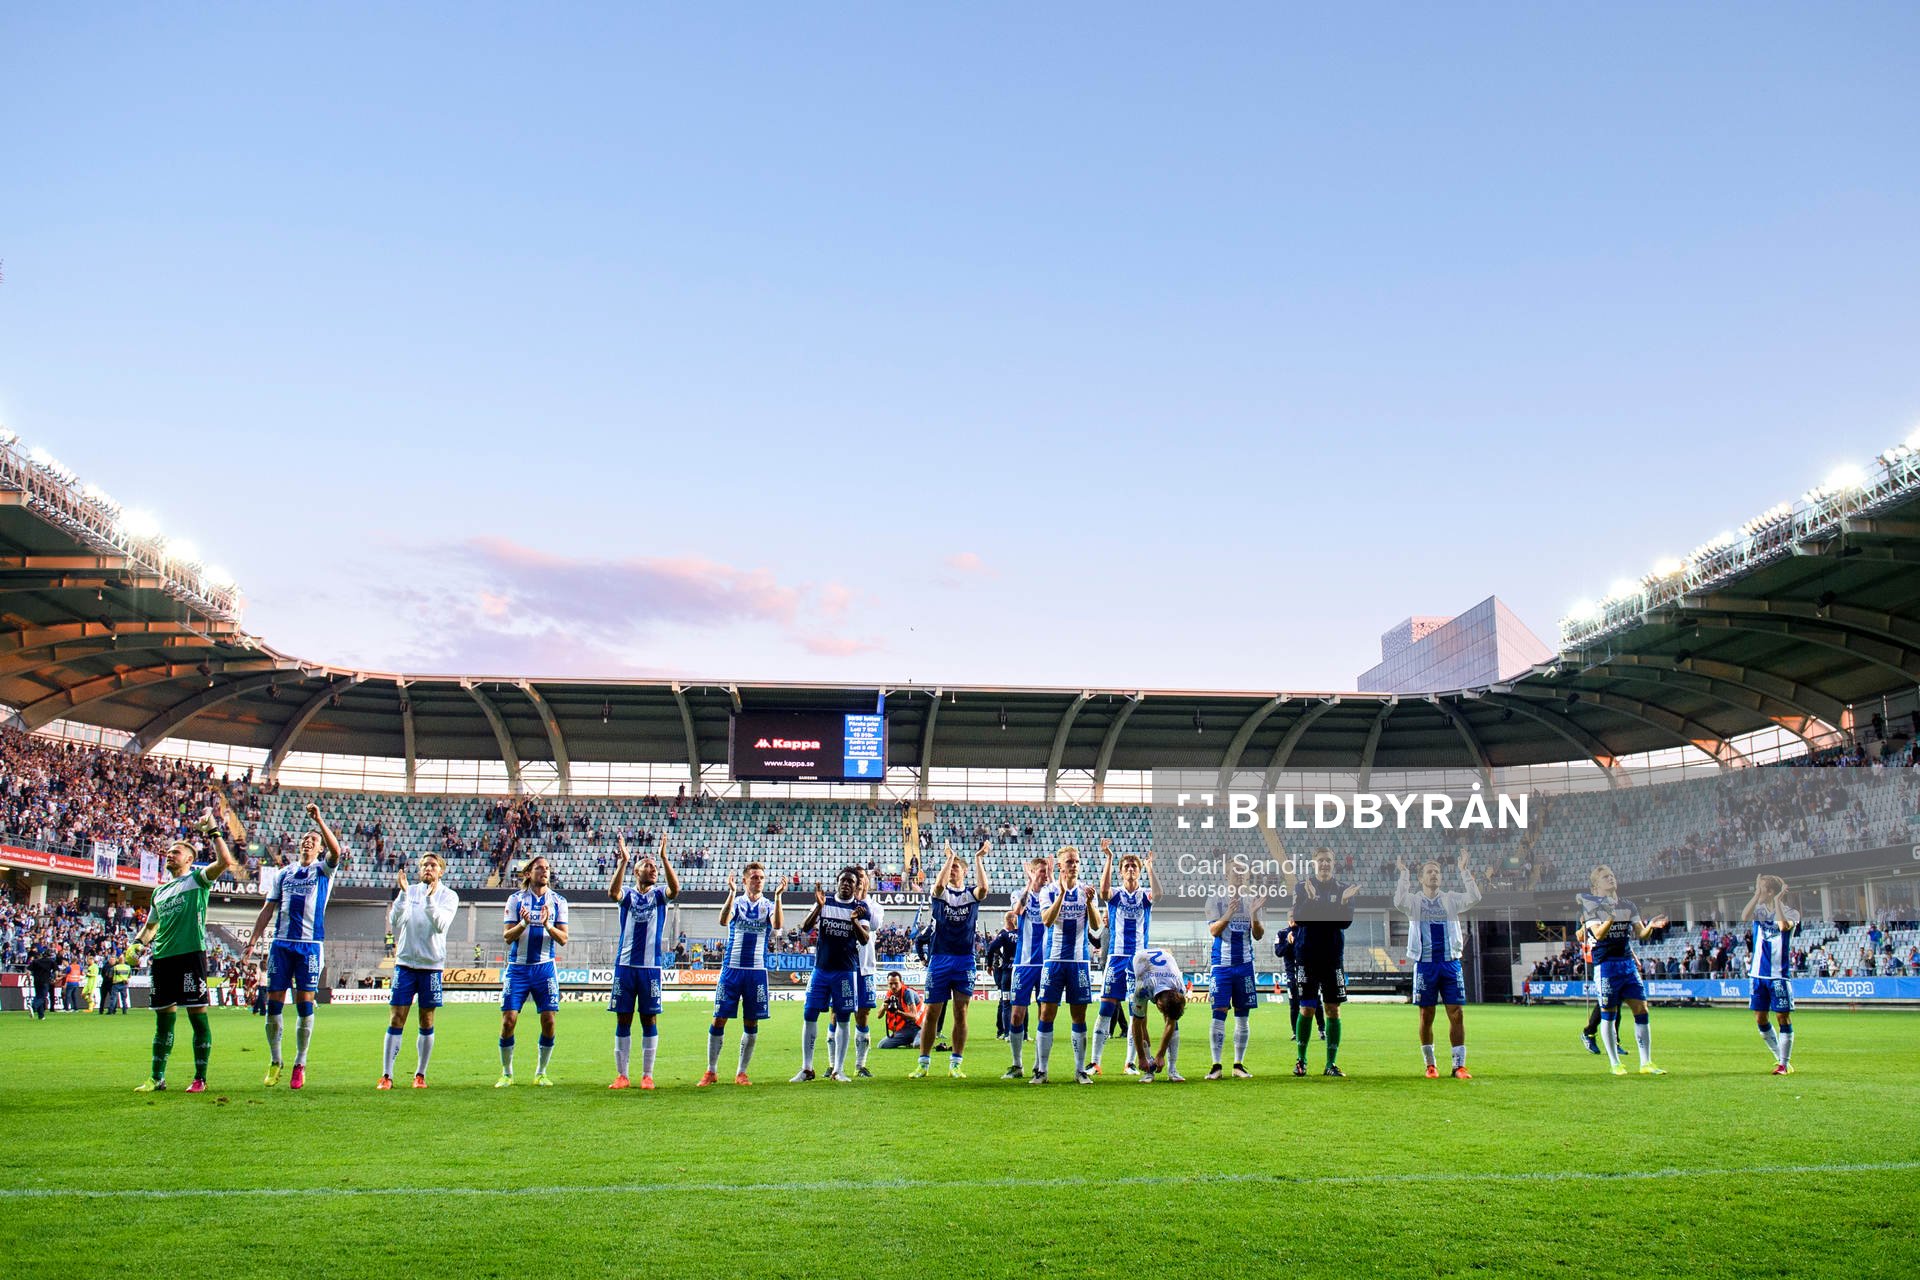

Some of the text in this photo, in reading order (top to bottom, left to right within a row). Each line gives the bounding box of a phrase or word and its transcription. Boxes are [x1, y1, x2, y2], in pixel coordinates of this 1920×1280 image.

[773, 739, 820, 750] Kappa
[767, 953, 815, 969] CKHOL
[1147, 950, 1168, 966] 2
[443, 969, 486, 983] dCash
[557, 971, 586, 983] ORG
[1549, 983, 1568, 995] SKF
[1828, 980, 1874, 997] Kappa
[451, 991, 502, 1003] SERNE
[560, 991, 612, 1003] XL-BYG
